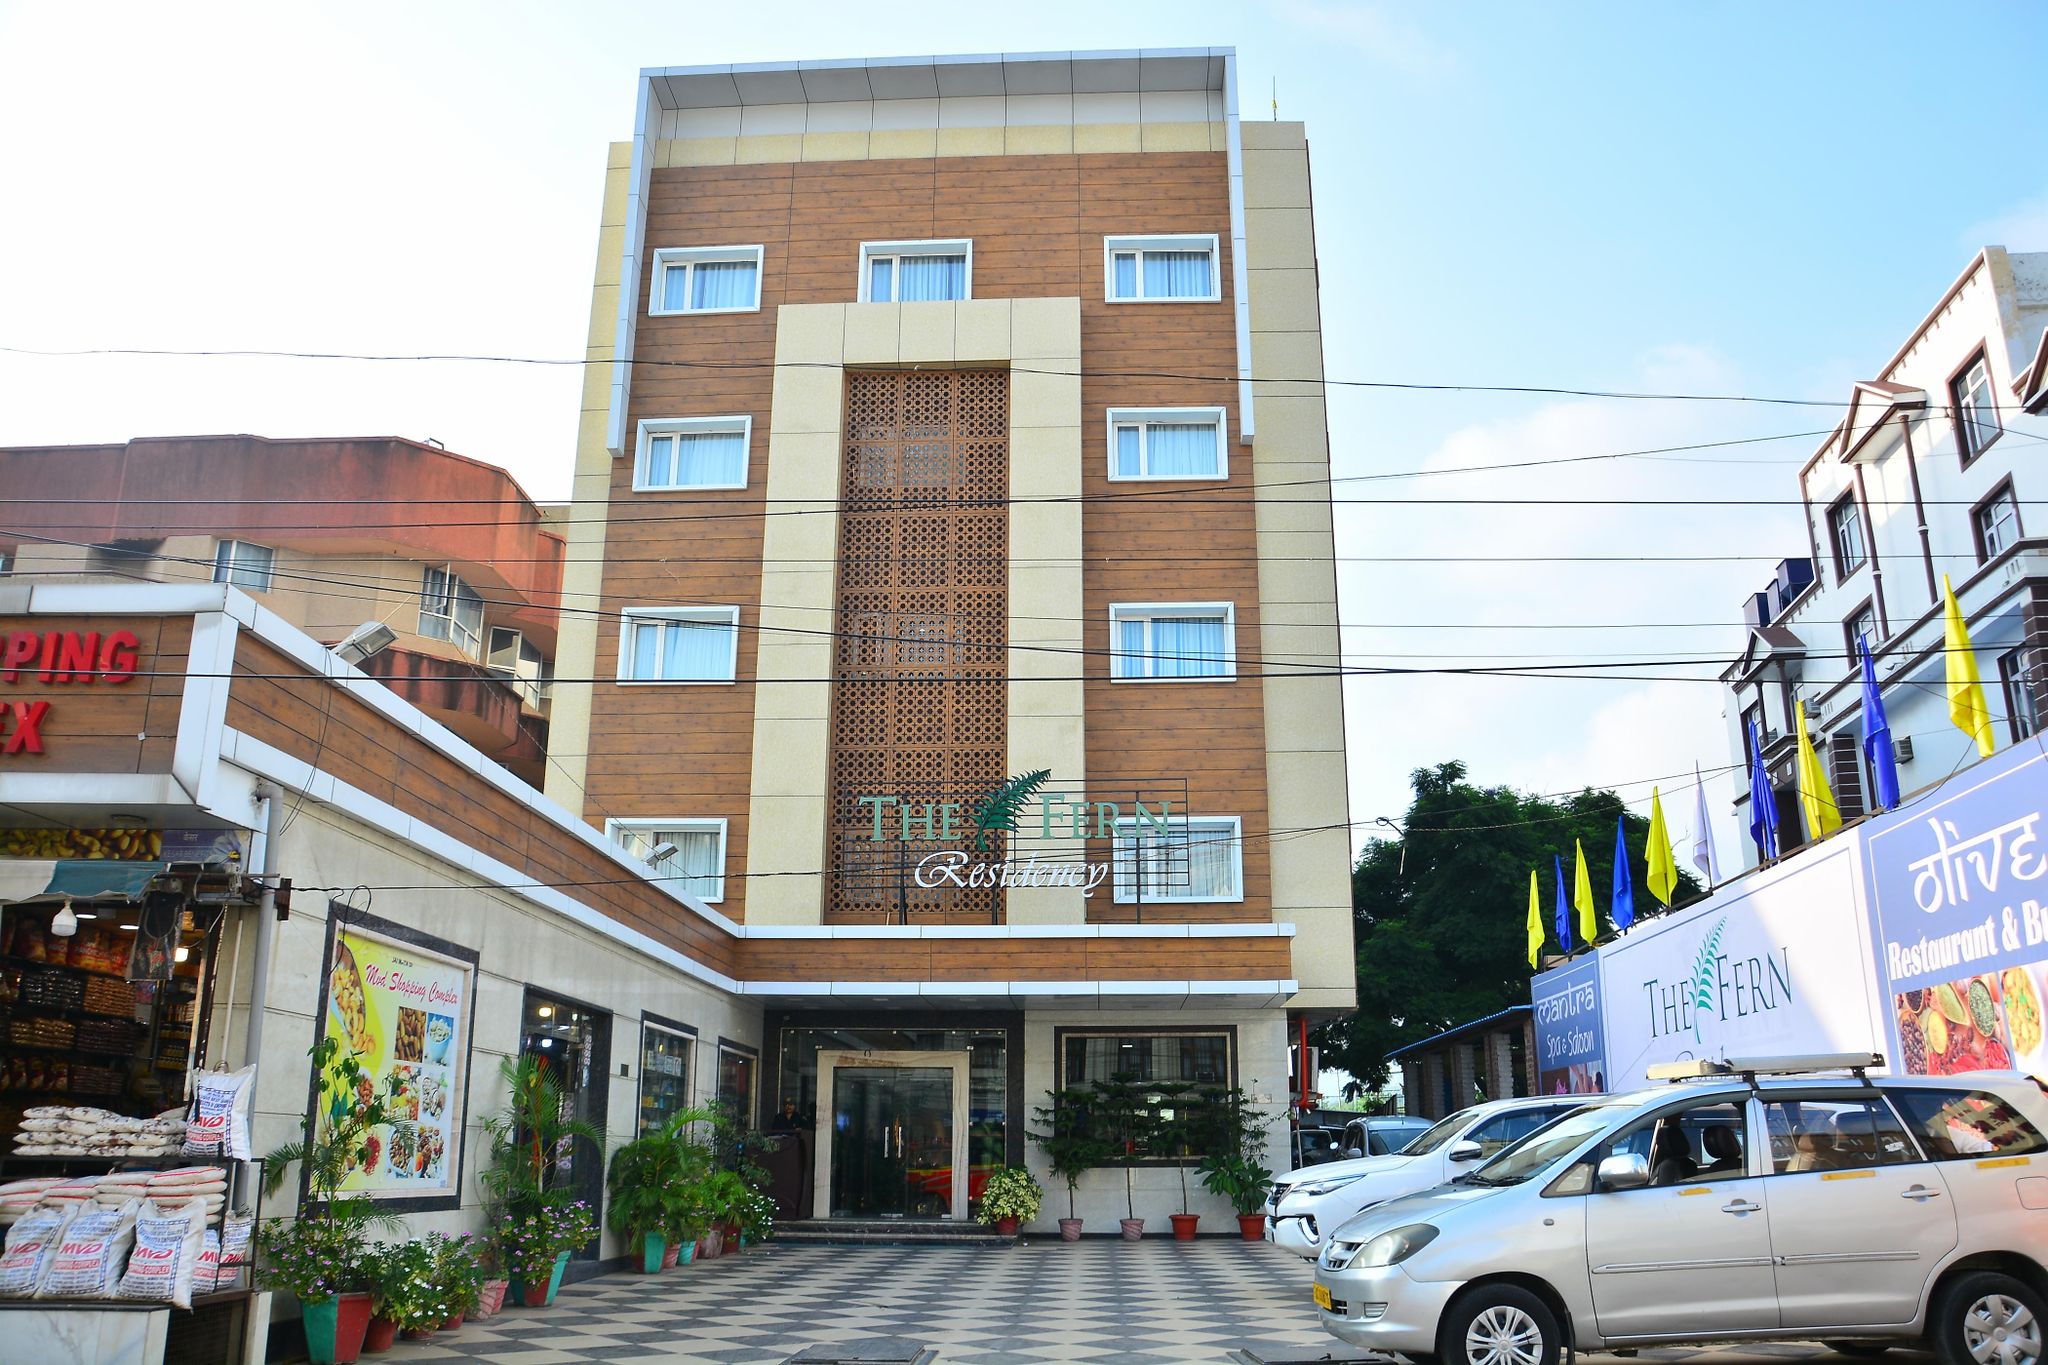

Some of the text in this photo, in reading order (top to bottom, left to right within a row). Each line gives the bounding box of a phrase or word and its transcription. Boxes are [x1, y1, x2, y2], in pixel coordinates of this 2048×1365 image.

[0, 629, 139, 684] PING
[858, 793, 1172, 842] THE FERN
[914, 850, 1109, 898] Residency
[1887, 915, 1999, 981] Restaurant
[2001, 905, 2022, 951] &
[389, 971, 426, 1003] Shopping
[1536, 980, 1595, 1026] mantra
[1643, 946, 1793, 1038] THE FERN
[1546, 1033, 1561, 1065] Spa
[1567, 1025, 1595, 1057] Saloon
[59, 1242, 103, 1255] MVD
